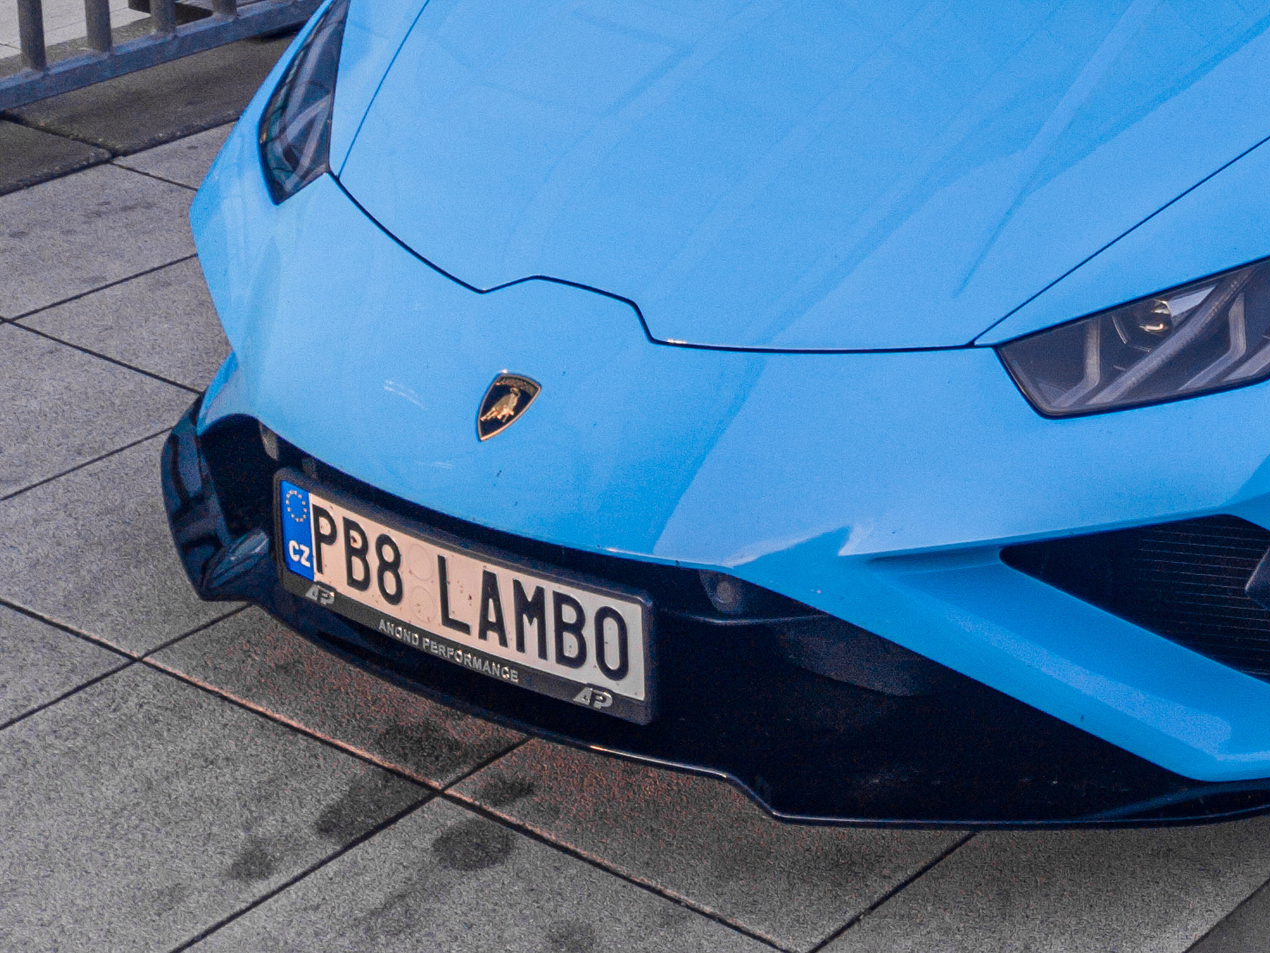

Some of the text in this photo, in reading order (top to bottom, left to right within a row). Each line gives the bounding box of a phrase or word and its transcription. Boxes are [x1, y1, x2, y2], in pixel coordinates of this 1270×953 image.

[288, 540, 311, 568] CZ
[311, 503, 630, 682] PB8 LAMBO
[422, 637, 520, 683] PERFORMANCE
